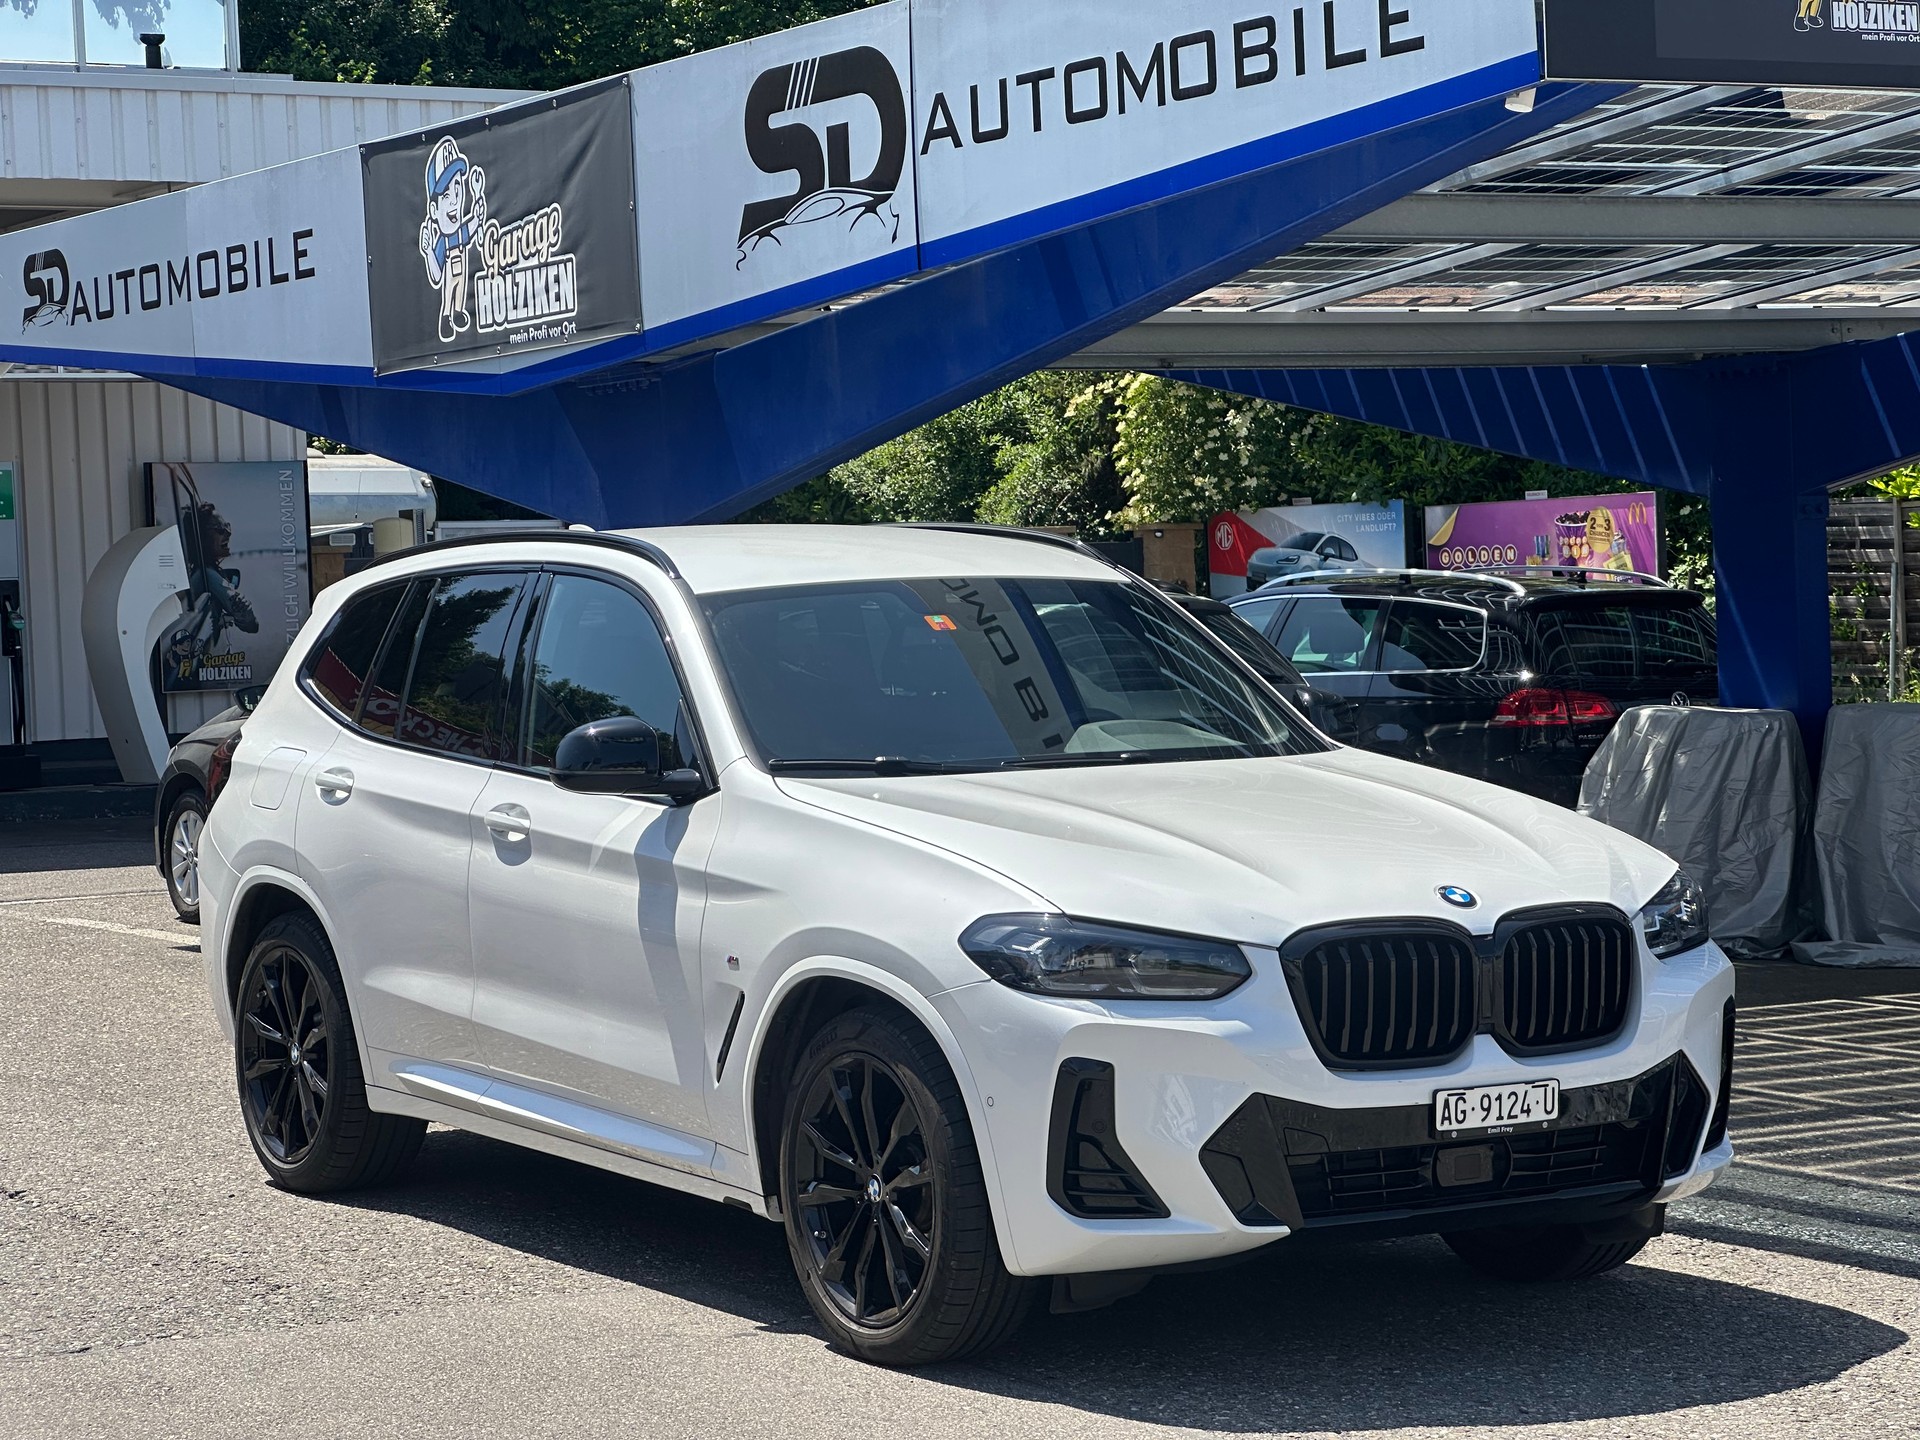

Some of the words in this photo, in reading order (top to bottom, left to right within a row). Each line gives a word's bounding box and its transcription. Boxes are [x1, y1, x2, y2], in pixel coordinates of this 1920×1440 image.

[1831, 1, 1918, 31] HOLZIKEN
[1861, 33, 1878, 41] mein
[1879, 33, 1896, 42] Profi
[1908, 34, 1920, 42] Ort
[737, 46, 906, 248] SD
[920, 0, 1425, 156] AUTOMOBILE
[485, 209, 559, 279] Garage
[22, 248, 70, 325] SD
[70, 228, 316, 326] AUTOMOBILE
[477, 261, 574, 325] HOLZIKEN
[510, 329, 528, 344] mein
[529, 324, 548, 340] Profi
[549, 326, 561, 338] vor
[562, 321, 576, 335] Ort
[1337, 514, 1353, 523] CITY
[1355, 512, 1375, 521] VIBES
[1377, 511, 1396, 520] ODER
[1356, 522, 1397, 533] LANDLUFT?
[1590, 517, 1596, 529] 2
[1604, 519, 1611, 531] 3
[279, 469, 299, 589] WILLKOMMEN
[1216, 522, 1233, 550] MG
[1441, 547, 1516, 565] GOLDEN
[203, 652, 245, 666] Garage
[199, 666, 251, 681] HOLZIKEN
